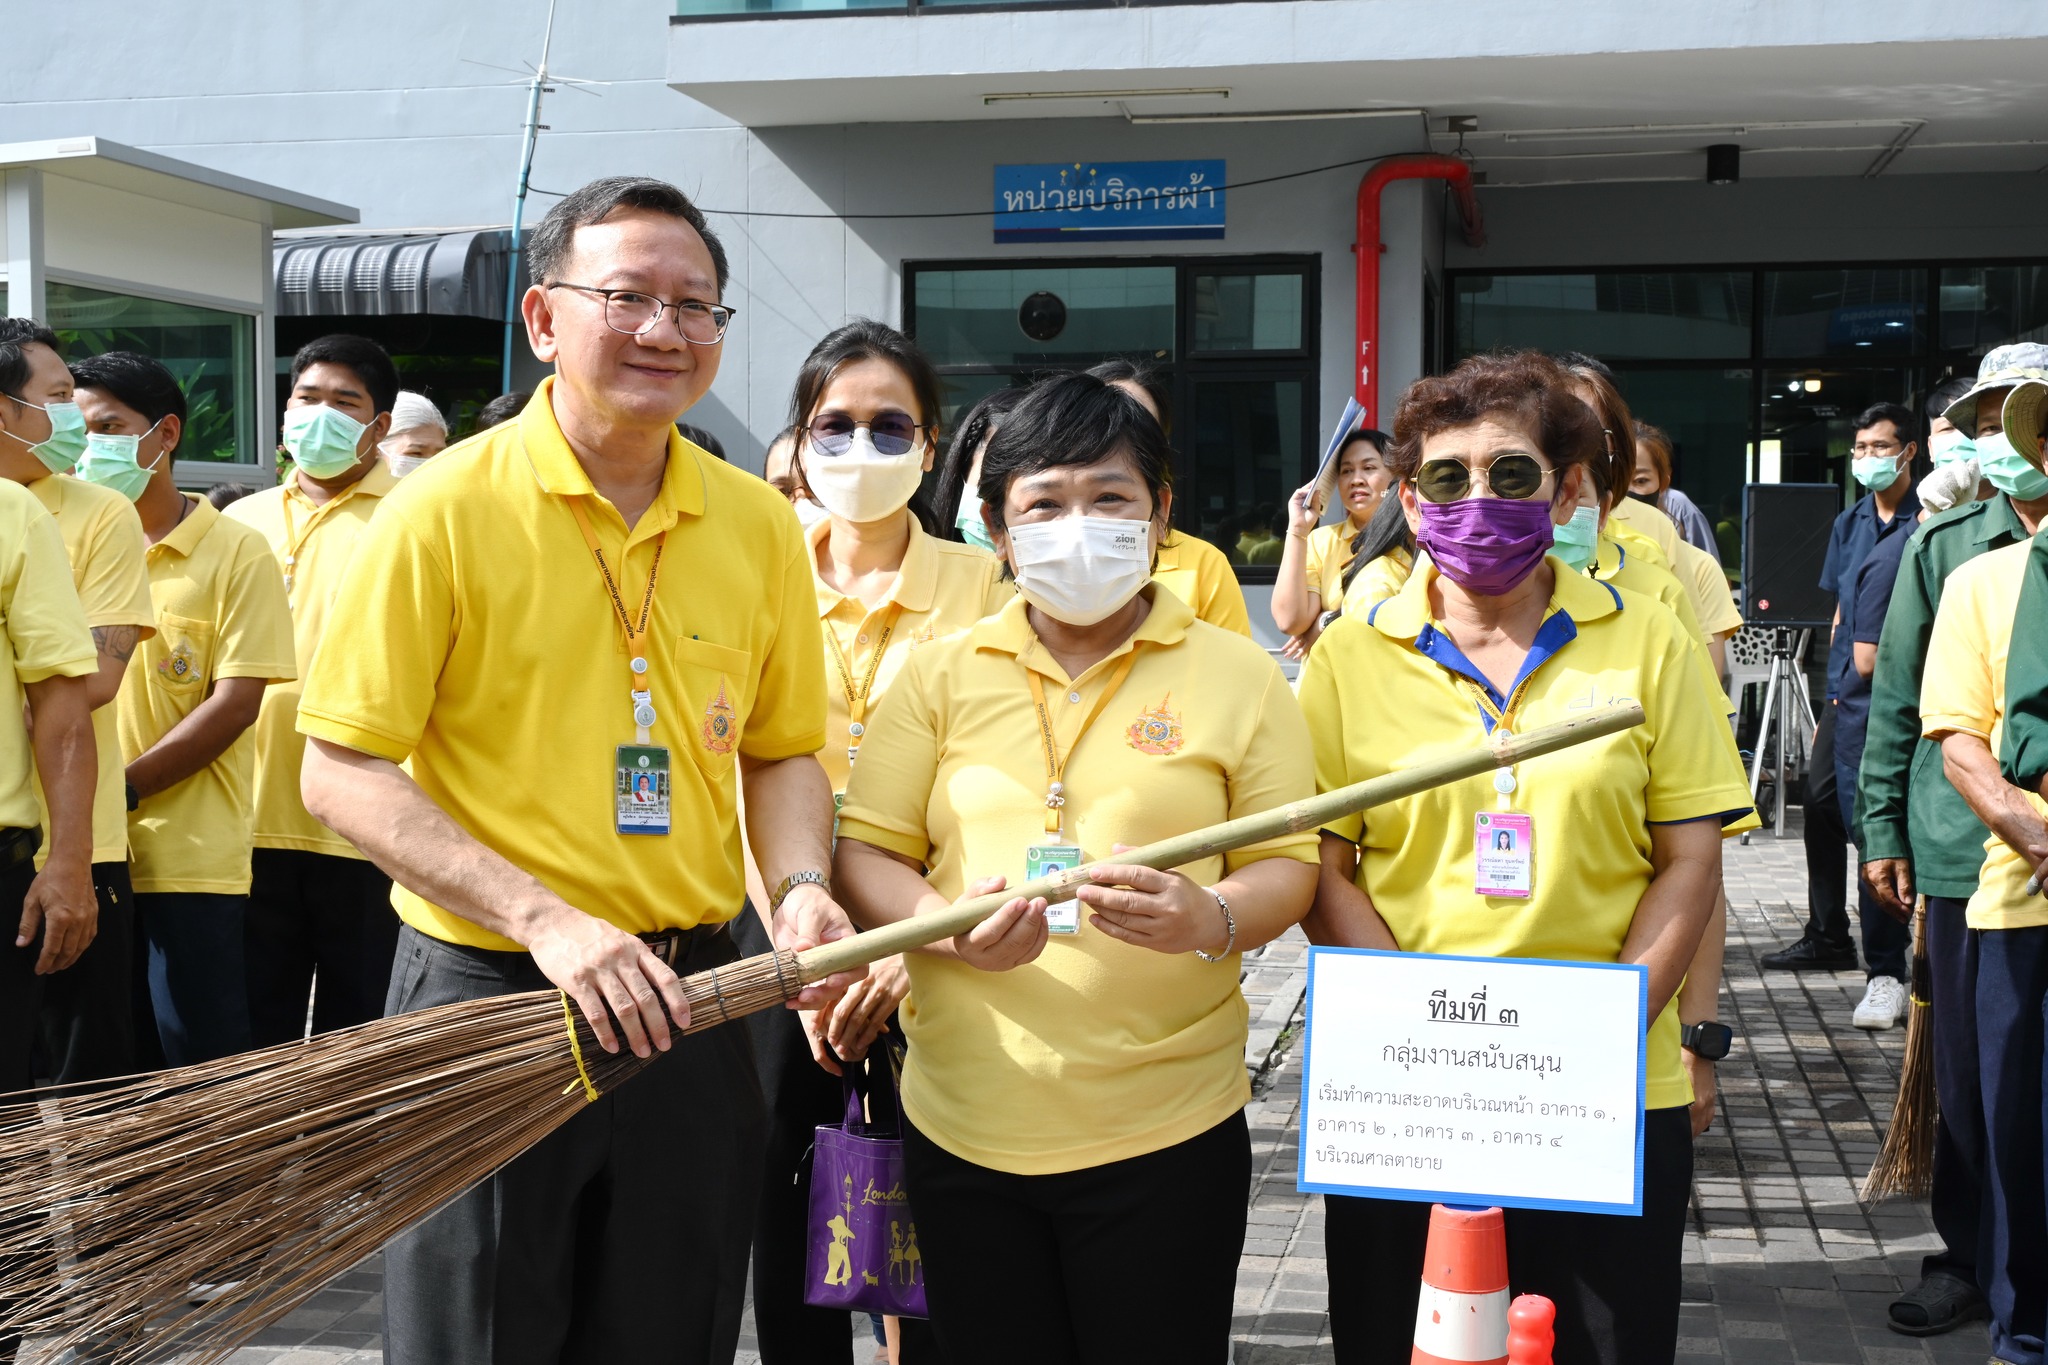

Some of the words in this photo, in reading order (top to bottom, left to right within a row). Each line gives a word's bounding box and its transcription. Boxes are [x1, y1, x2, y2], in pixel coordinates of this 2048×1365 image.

[1003, 172, 1216, 213] หน่วยบริการผ้า
[1362, 341, 1371, 355] F
[1115, 533, 1136, 544] zion
[1427, 985, 1487, 1022] ทีมที่
[1499, 1007, 1519, 1024] ๓
[1383, 1038, 1562, 1081] กลุ่มงานสนับสนุน
[1318, 1079, 1533, 1116] เริ่มทำความสะอาดบริเวณหน้า
[1540, 1103, 1587, 1119] อาคาร
[1593, 1109, 1606, 1121] ๑
[1317, 1117, 1366, 1134] อาคาร
[1373, 1120, 1386, 1136] ๒
[1404, 1123, 1454, 1141] อาคาร
[1461, 1130, 1474, 1142] ๓
[1493, 1130, 1542, 1147] อาคาร
[1550, 1134, 1563, 1149] ๔
[1315, 1144, 1443, 1171] บริเวณศาลตายาย
